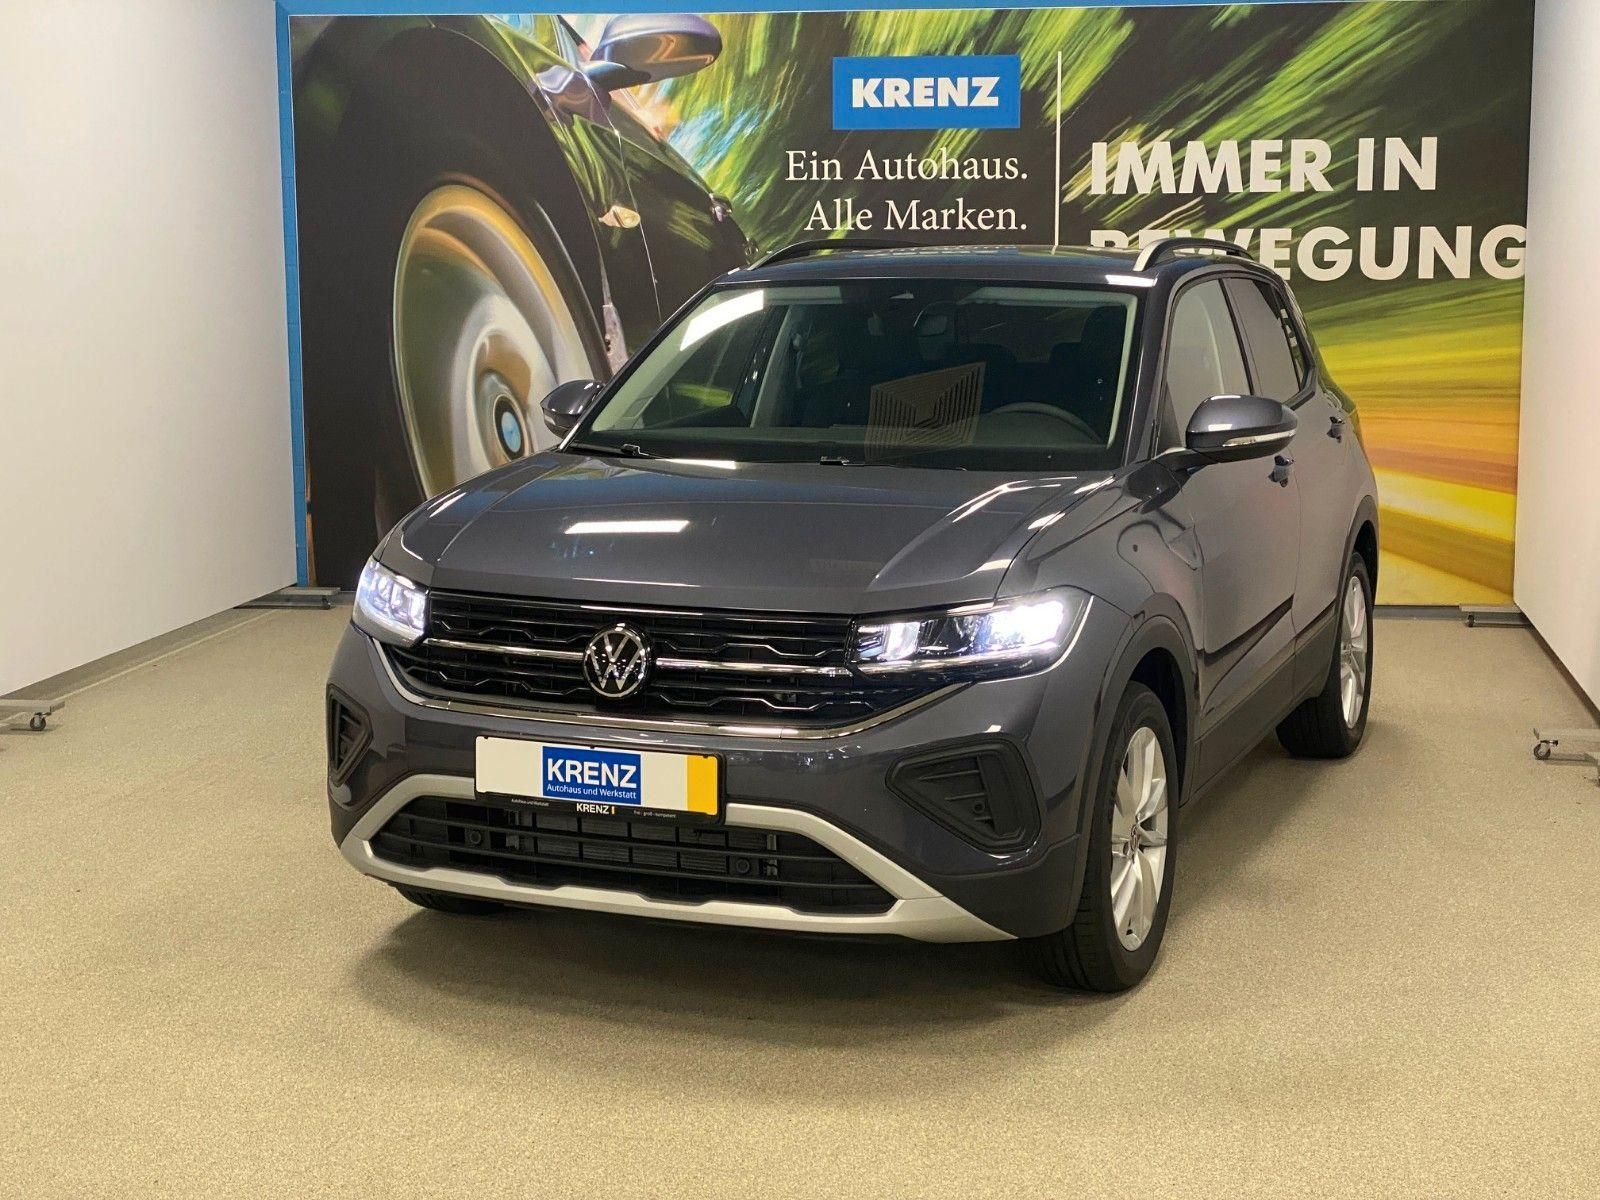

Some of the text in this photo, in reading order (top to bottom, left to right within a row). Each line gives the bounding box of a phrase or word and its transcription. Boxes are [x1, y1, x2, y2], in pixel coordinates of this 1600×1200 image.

[852, 76, 1000, 108] KRENZ
[785, 147, 1028, 181] Ein Autohaus.
[1091, 136, 1438, 194] IMMER IN
[804, 197, 1027, 231] Alle Marken.
[1090, 224, 1527, 282] EGUNG
[547, 757, 637, 789] KRENZ
[546, 783, 637, 800] Autohaus und Werkstatt
[576, 802, 610, 815] KRENZ
